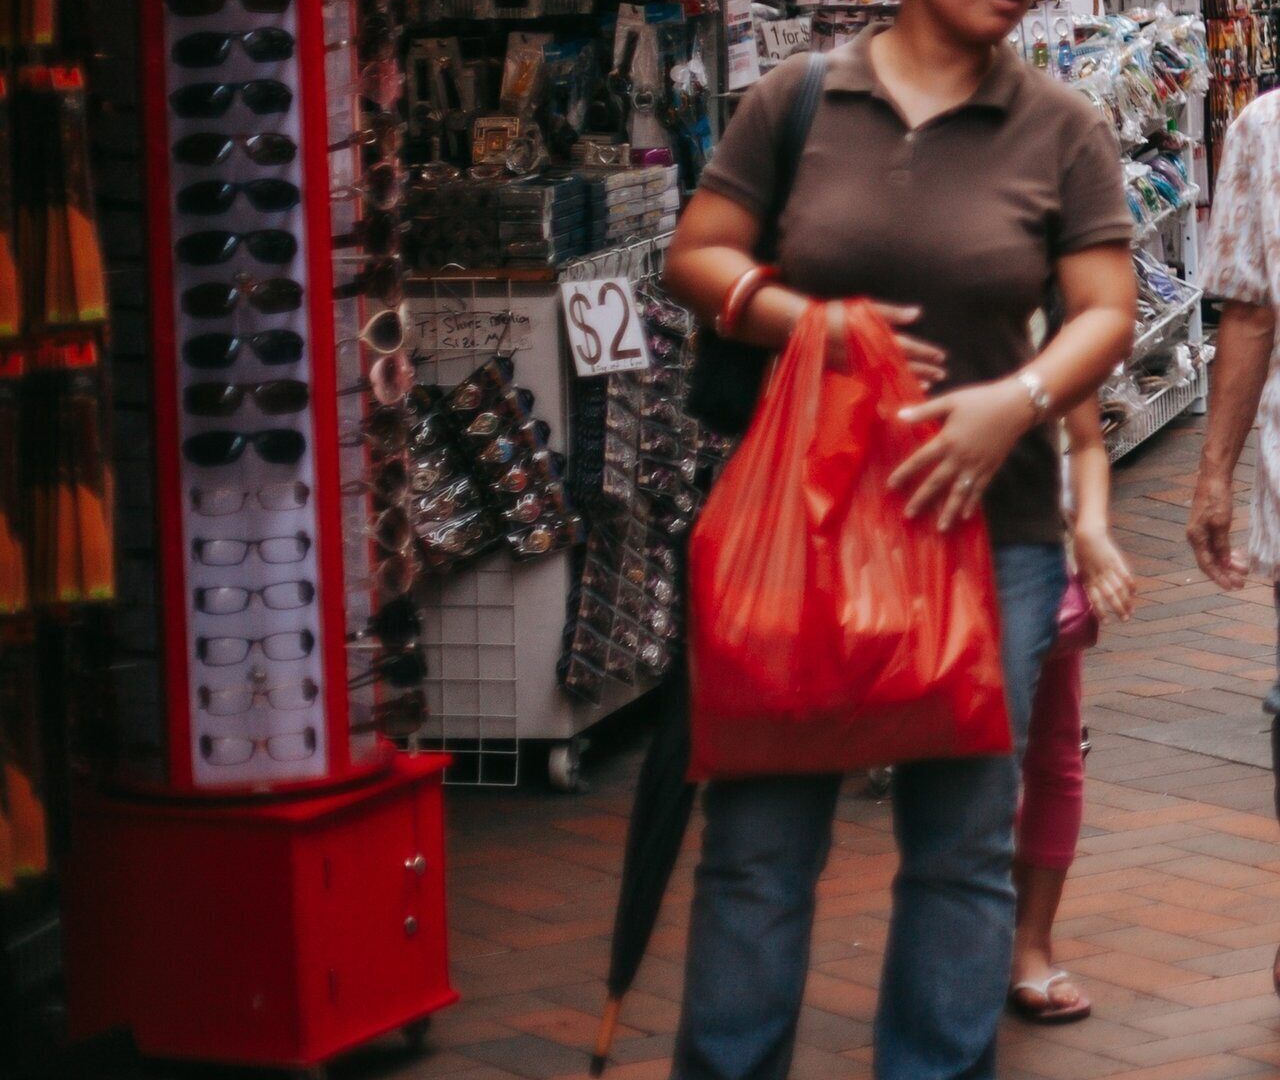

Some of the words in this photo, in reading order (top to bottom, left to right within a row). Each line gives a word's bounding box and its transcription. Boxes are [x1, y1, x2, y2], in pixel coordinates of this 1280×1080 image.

[771, 25, 780, 46] 1
[782, 28, 799, 45] for
[568, 282, 641, 366] $2
